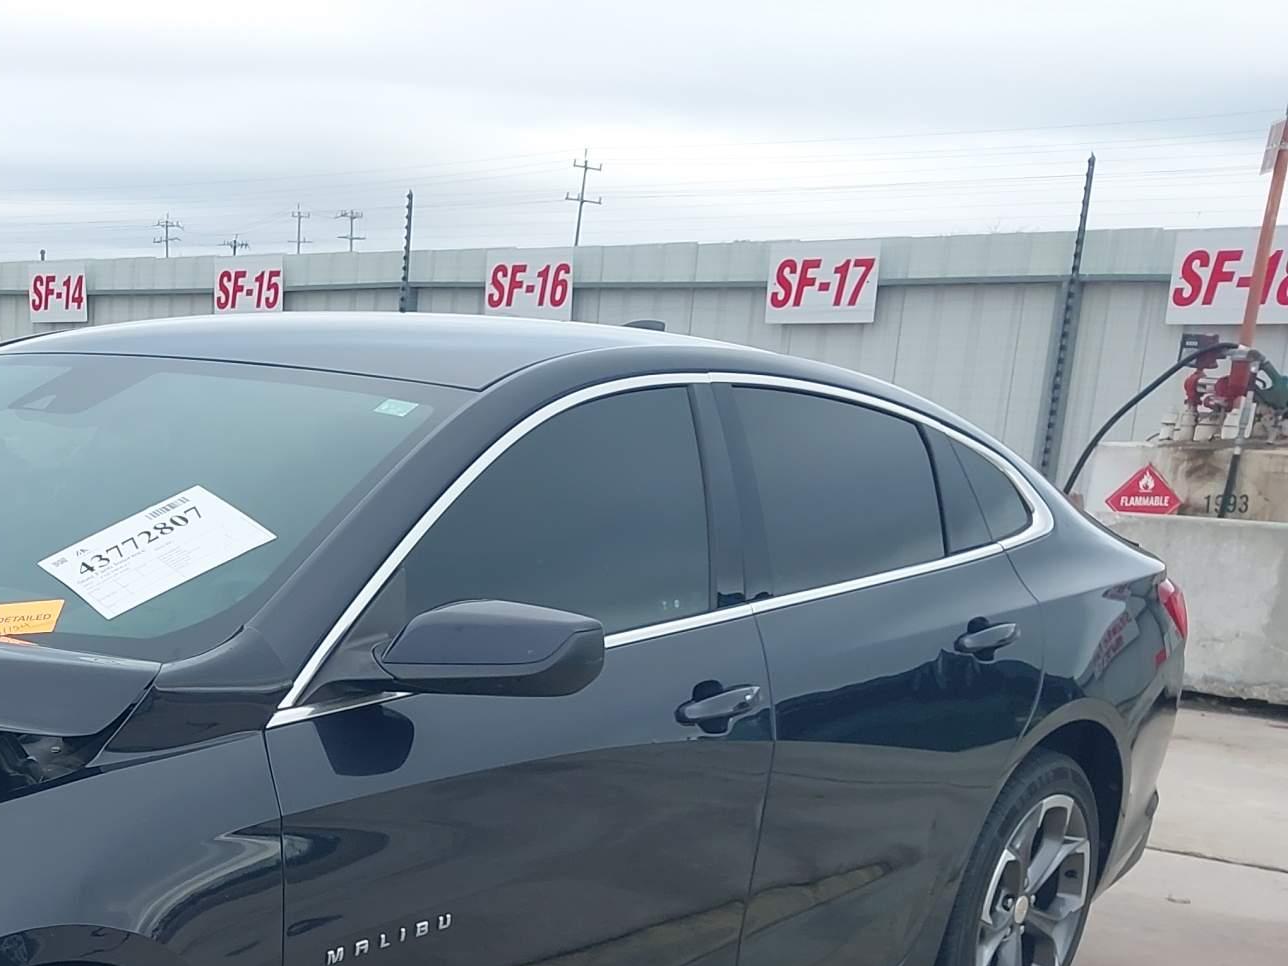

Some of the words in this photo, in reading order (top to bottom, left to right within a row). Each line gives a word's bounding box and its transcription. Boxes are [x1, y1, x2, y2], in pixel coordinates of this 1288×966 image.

[31, 274, 84, 311] SF-14
[216, 270, 281, 310] SF-15
[487, 263, 571, 309] SF-16
[770, 258, 876, 309] SF-17
[1120, 495, 1170, 507] FLAMMABLE
[79, 506, 202, 575] 43772807
[326, 913, 452, 966] MALIBU
